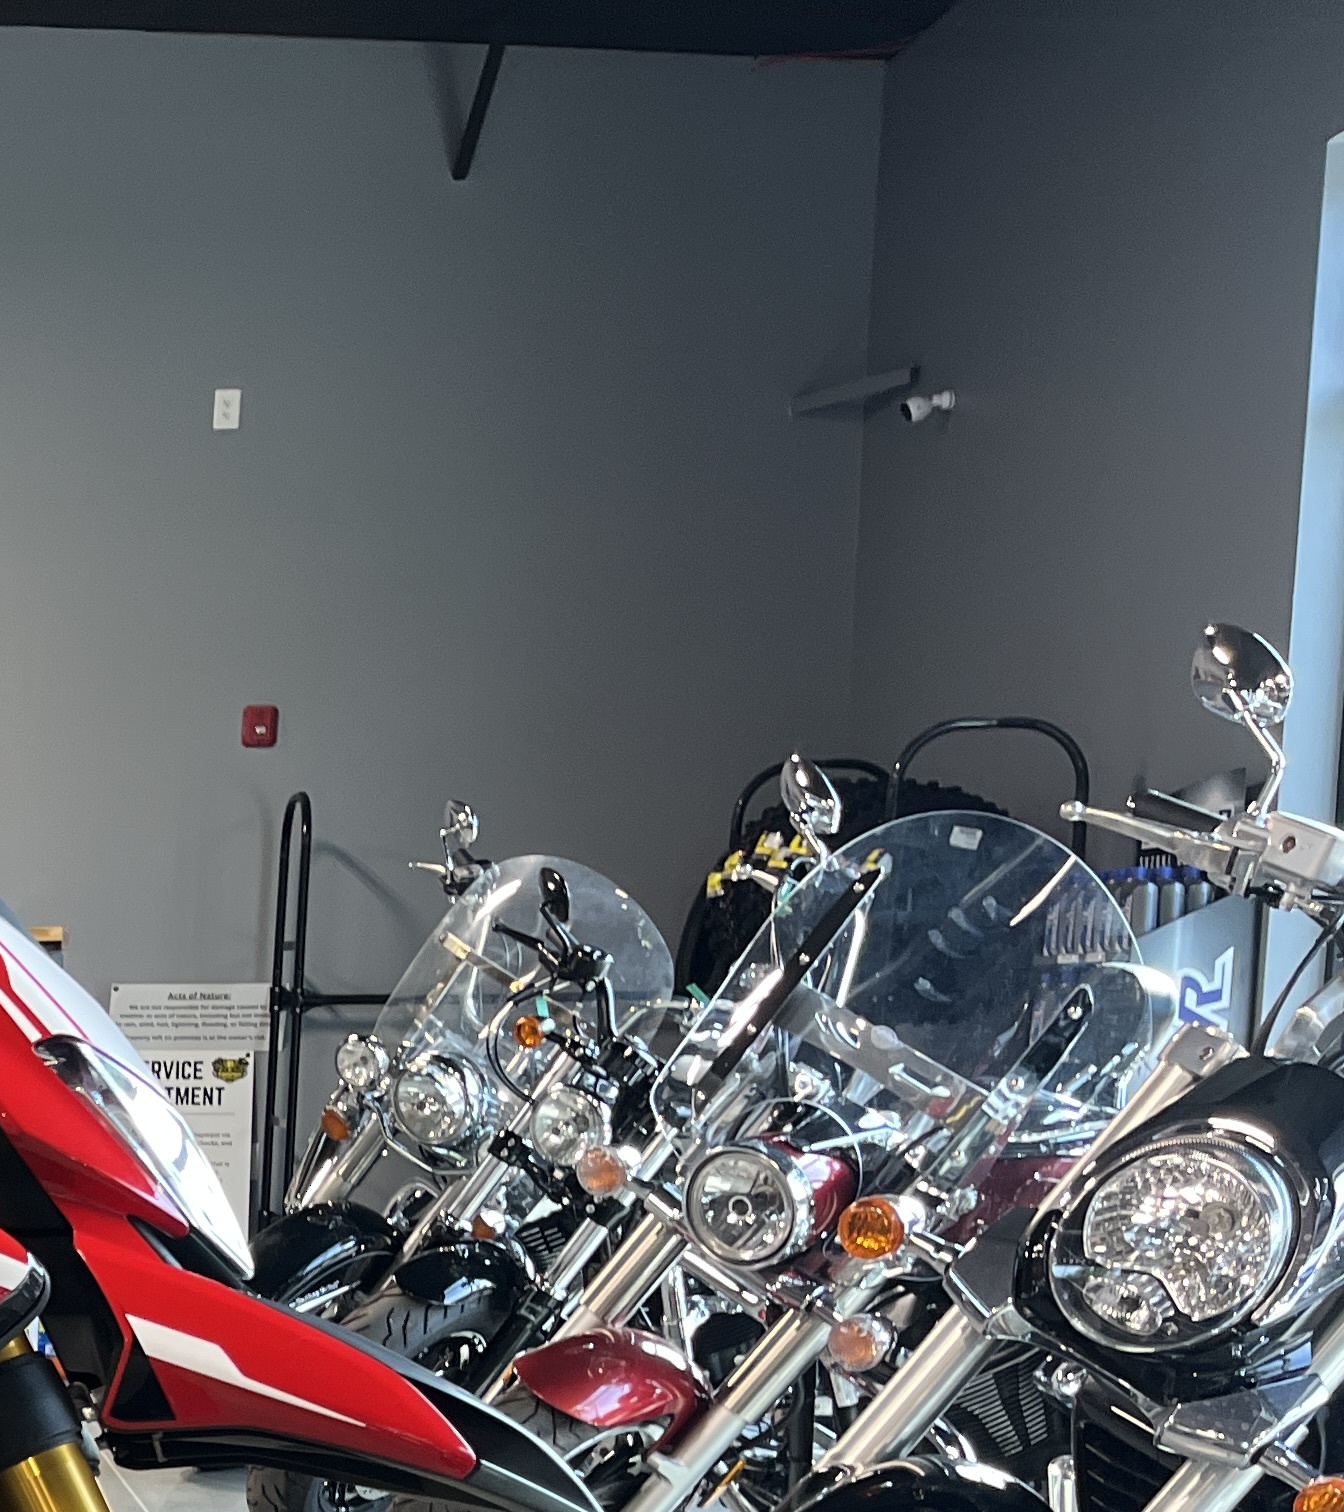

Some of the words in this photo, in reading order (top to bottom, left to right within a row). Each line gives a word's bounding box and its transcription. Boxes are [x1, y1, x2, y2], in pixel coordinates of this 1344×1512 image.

[167, 992, 187, 1001] Acts
[188, 992, 198, 1001] of
[149, 1060, 204, 1080] RVICE
[166, 1086, 225, 1106] TMENT
